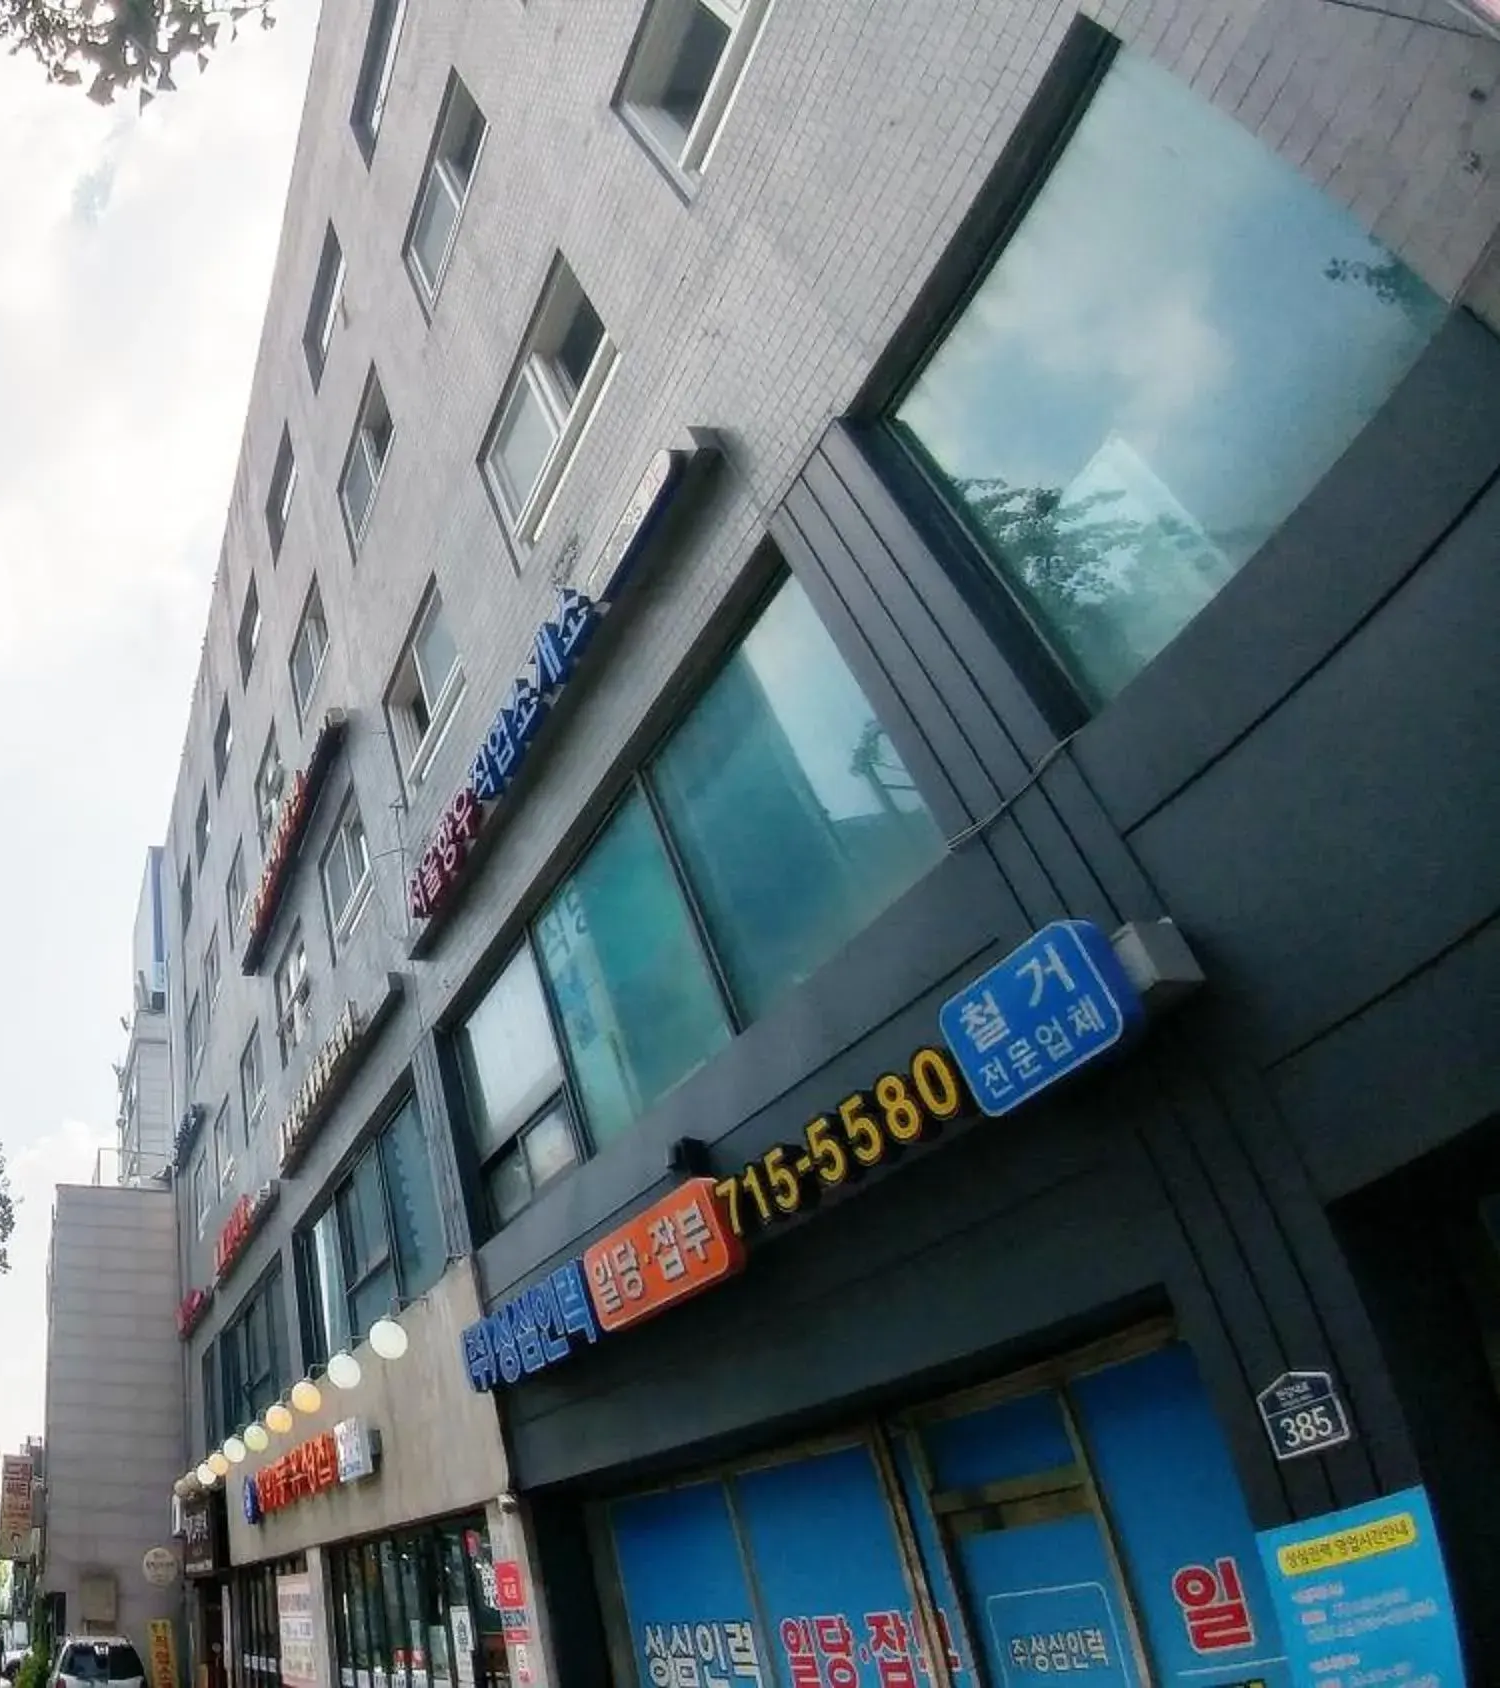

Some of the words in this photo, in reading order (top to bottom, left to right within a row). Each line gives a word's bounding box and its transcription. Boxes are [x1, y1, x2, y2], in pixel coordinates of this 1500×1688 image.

[959, 942, 1076, 1054] 철거
[978, 994, 1106, 1099] 전문업체
[714, 1045, 961, 1237] 715-5580
[1280, 1404, 1334, 1448] 385
[643, 1617, 764, 1688] 성심인력
[1172, 1556, 1253, 1653] 일
